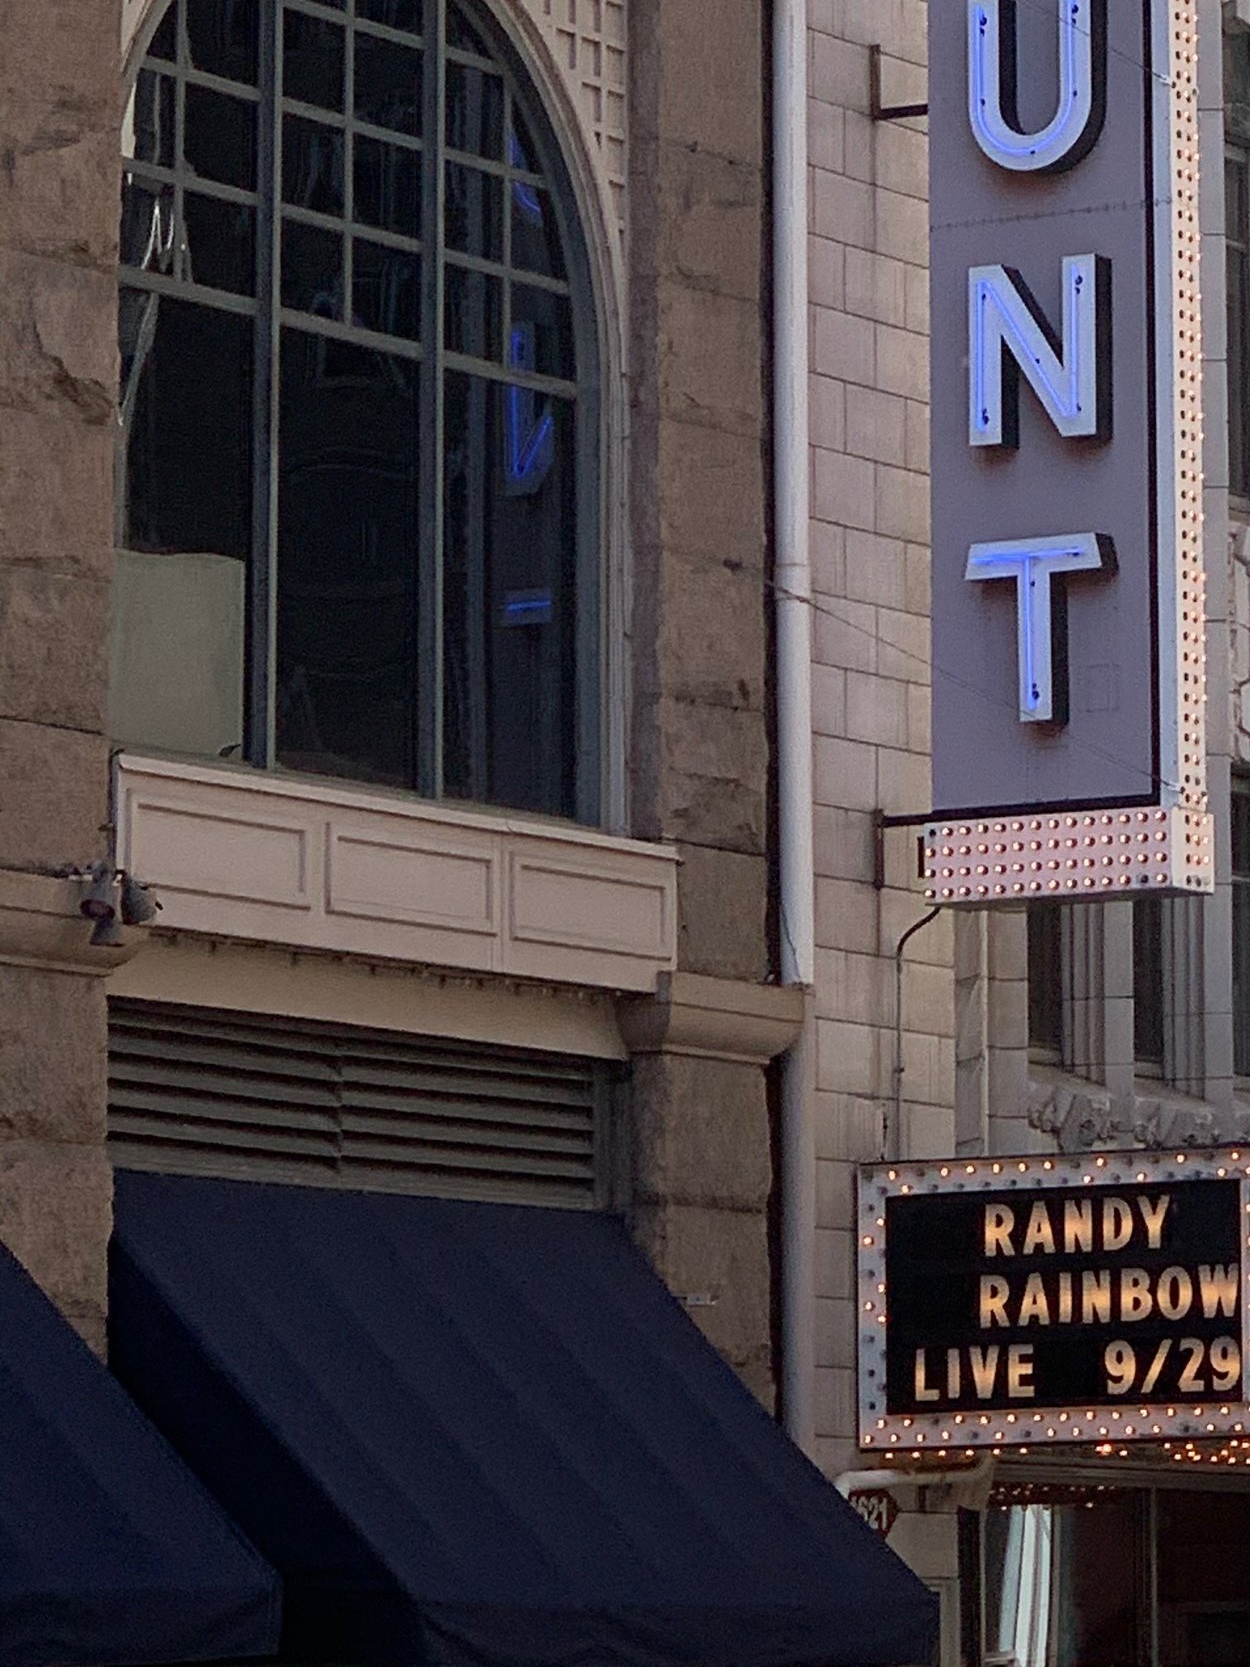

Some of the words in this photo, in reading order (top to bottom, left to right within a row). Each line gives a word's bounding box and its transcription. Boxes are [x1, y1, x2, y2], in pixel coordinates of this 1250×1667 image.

[984, 1194, 1170, 1257] RANDY
[979, 1262, 1239, 1329] RAINBOW
[915, 1343, 1035, 1402] LIVE
[1104, 1336, 1241, 1395] 9/29
